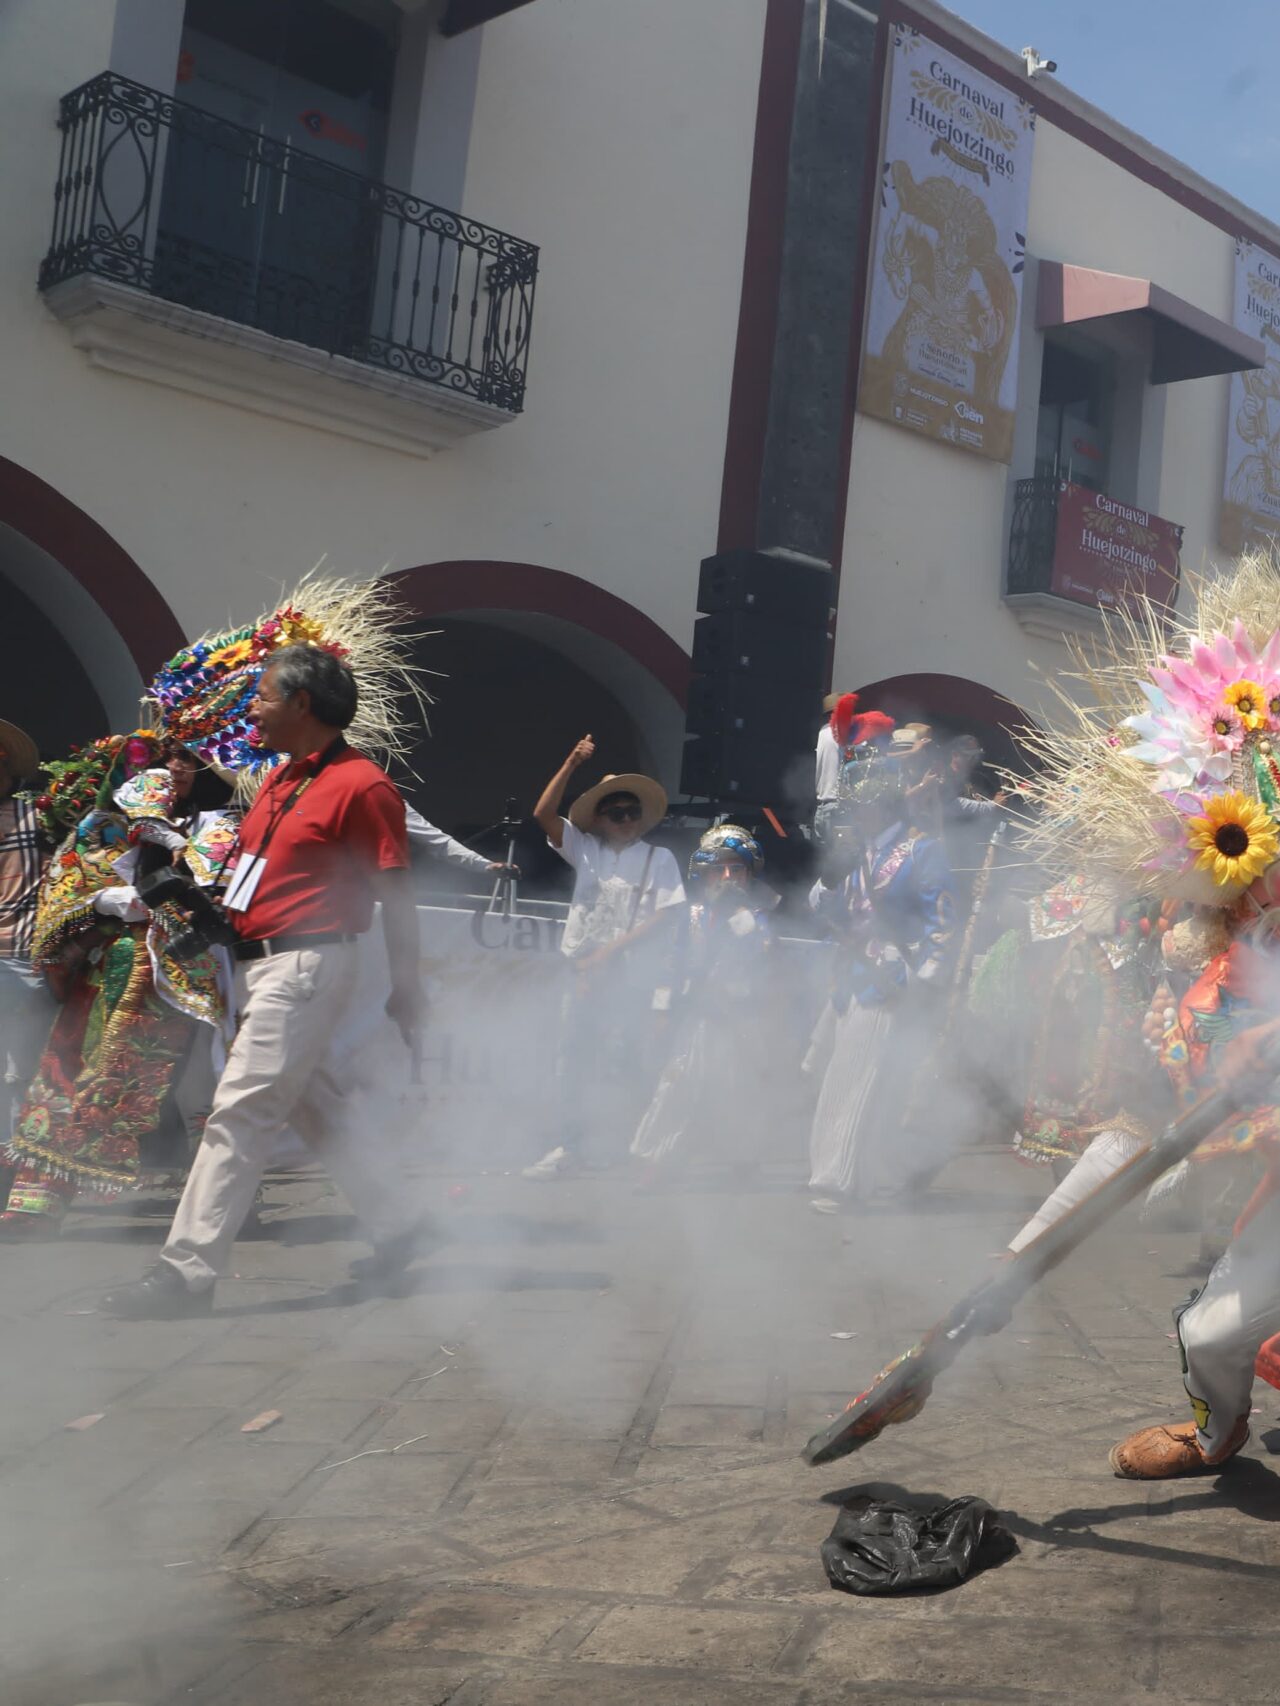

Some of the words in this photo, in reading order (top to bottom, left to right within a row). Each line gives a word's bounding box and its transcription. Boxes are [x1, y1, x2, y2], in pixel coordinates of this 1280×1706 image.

[930, 61, 1004, 120] Carnaval
[959, 105, 974, 121] de
[910, 97, 1015, 176] Huejotzingo
[1096, 494, 1149, 527] Carnaval
[1117, 524, 1126, 535] de
[1082, 528, 1157, 572] Huejotzingo
